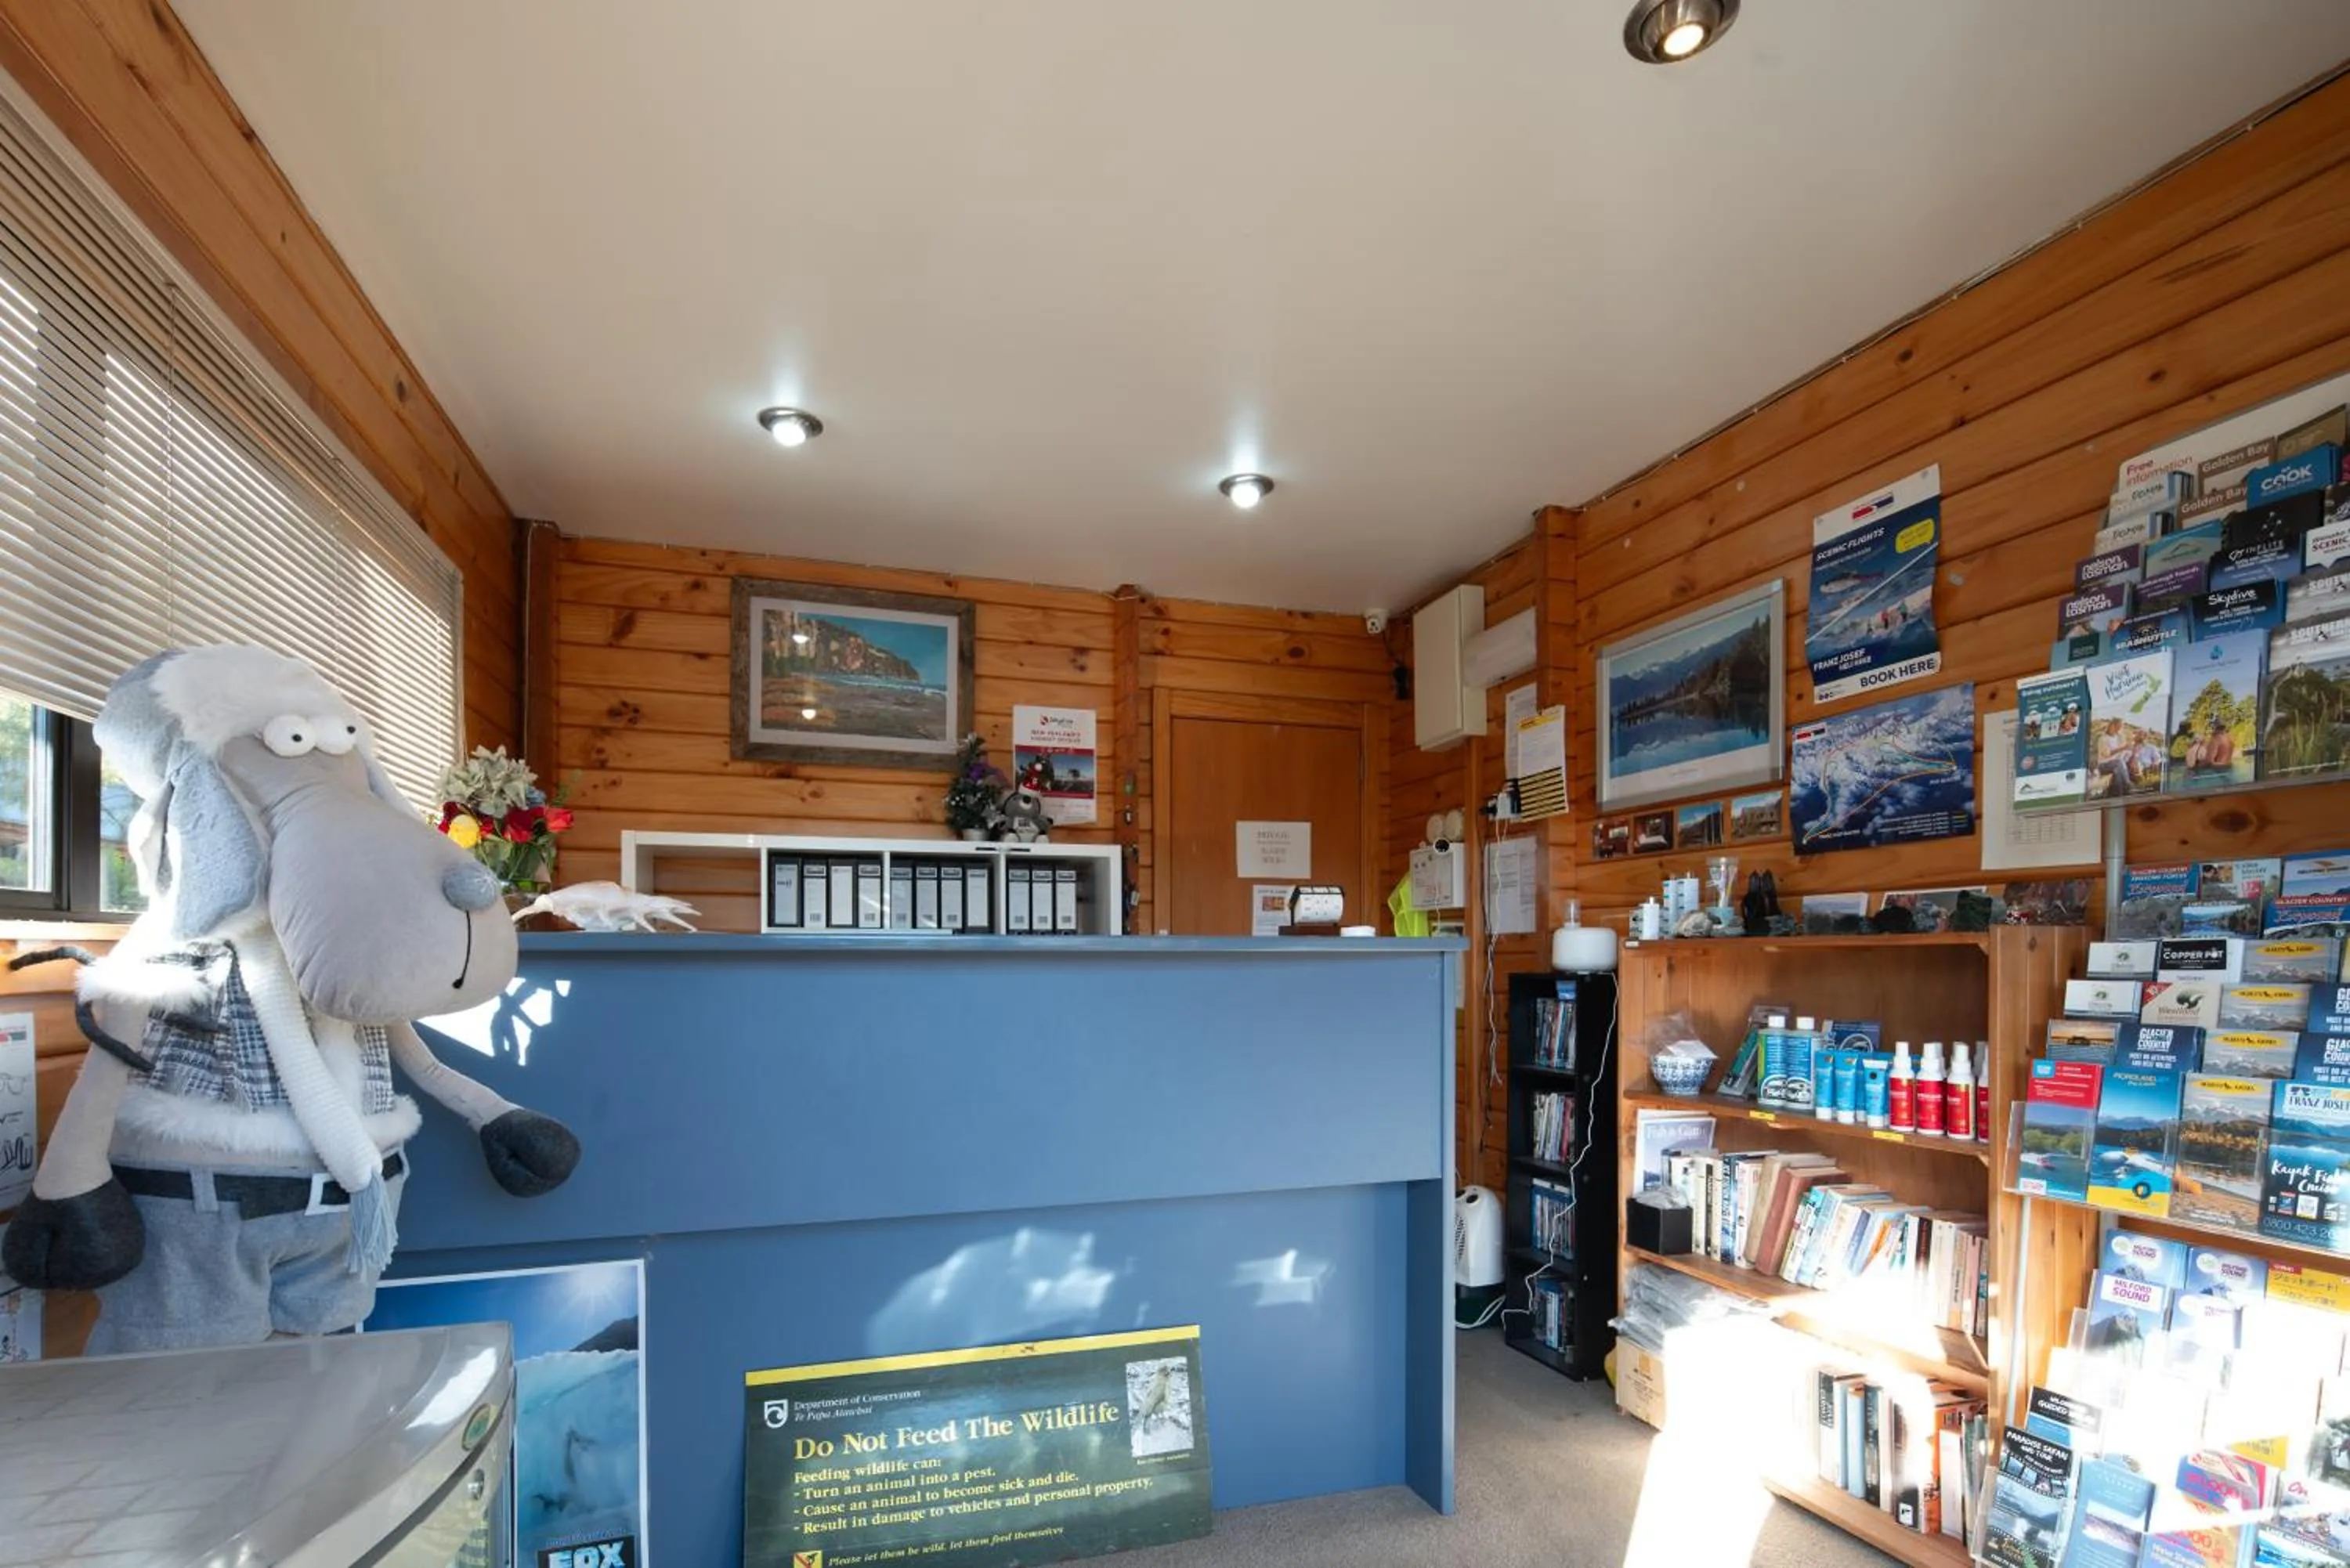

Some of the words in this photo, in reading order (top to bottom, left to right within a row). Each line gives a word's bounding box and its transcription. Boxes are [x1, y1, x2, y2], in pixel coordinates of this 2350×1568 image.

[2202, 450, 2244, 472] Golden
[2247, 442, 2269, 459] Bay
[2182, 493, 2224, 513] Golden
[1817, 541, 1849, 562] SCENIC
[1849, 527, 1885, 550] FLIGHTS
[2081, 560, 2129, 580] tasman
[2082, 555, 2122, 574] nelson
[2065, 598, 2112, 618] tasman
[2066, 593, 2106, 610] nelson
[2208, 589, 2257, 607] Skydive
[1860, 668, 1896, 687] BOOK
[1899, 657, 1935, 678] HERE
[2163, 951, 2202, 960] COPPER
[2204, 947, 2225, 959] POT
[2288, 1095, 2320, 1108] FRANZ
[2271, 1159, 2312, 1185] Kayak
[2262, 1216, 2292, 1230] 0800
[2293, 1220, 2317, 1235] 423
[2112, 1286, 2151, 1304] SOUND
[2115, 1279, 2153, 1294] MILFORD
[794, 1397, 848, 1411] Department
[850, 1395, 861, 1405] of
[862, 1389, 921, 1403] Conservation
[794, 1413, 804, 1422] Te
[806, 1410, 832, 1422] Papa
[794, 1436, 834, 1460] Do
[841, 1430, 888, 1455] Not
[895, 1419, 957, 1448] Feed
[964, 1414, 1014, 1440] The
[1020, 1401, 1119, 1433] Wildlife
[794, 1467, 851, 1484] Feeding
[853, 1459, 909, 1476] wildlife
[913, 1458, 941, 1469] can:
[803, 1487, 840, 1500] Turn
[844, 1483, 862, 1496] an
[866, 1475, 916, 1493] animal
[920, 1472, 948, 1486] into
[952, 1471, 960, 1482] a
[964, 1466, 996, 1483] pest.
[803, 1502, 845, 1517] Cause
[850, 1499, 867, 1512] an
[871, 1491, 922, 1509] animal
[925, 1490, 939, 1501] to
[944, 1483, 995, 1499] become
[999, 1476, 1025, 1491] sick
[1028, 1473, 1053, 1487] and
[1056, 1469, 1079, 1483] die.
[803, 1518, 847, 1534] Result
[851, 1516, 867, 1528] in
[871, 1508, 926, 1526] damage
[930, 1507, 944, 1518] to
[948, 1495, 1002, 1515] vehicles
[1005, 1492, 1030, 1507] and
[1034, 1484, 1091, 1505] personal
[828, 1555, 862, 1567] Please
[865, 1553, 877, 1562] let
[880, 1548, 906, 1560] them
[907, 1546, 920, 1556] be
[950, 1541, 964, 1550] let
[965, 1537, 989, 1548] them
[990, 1532, 1013, 1545] feed
[1014, 1526, 1065, 1541] themselves
